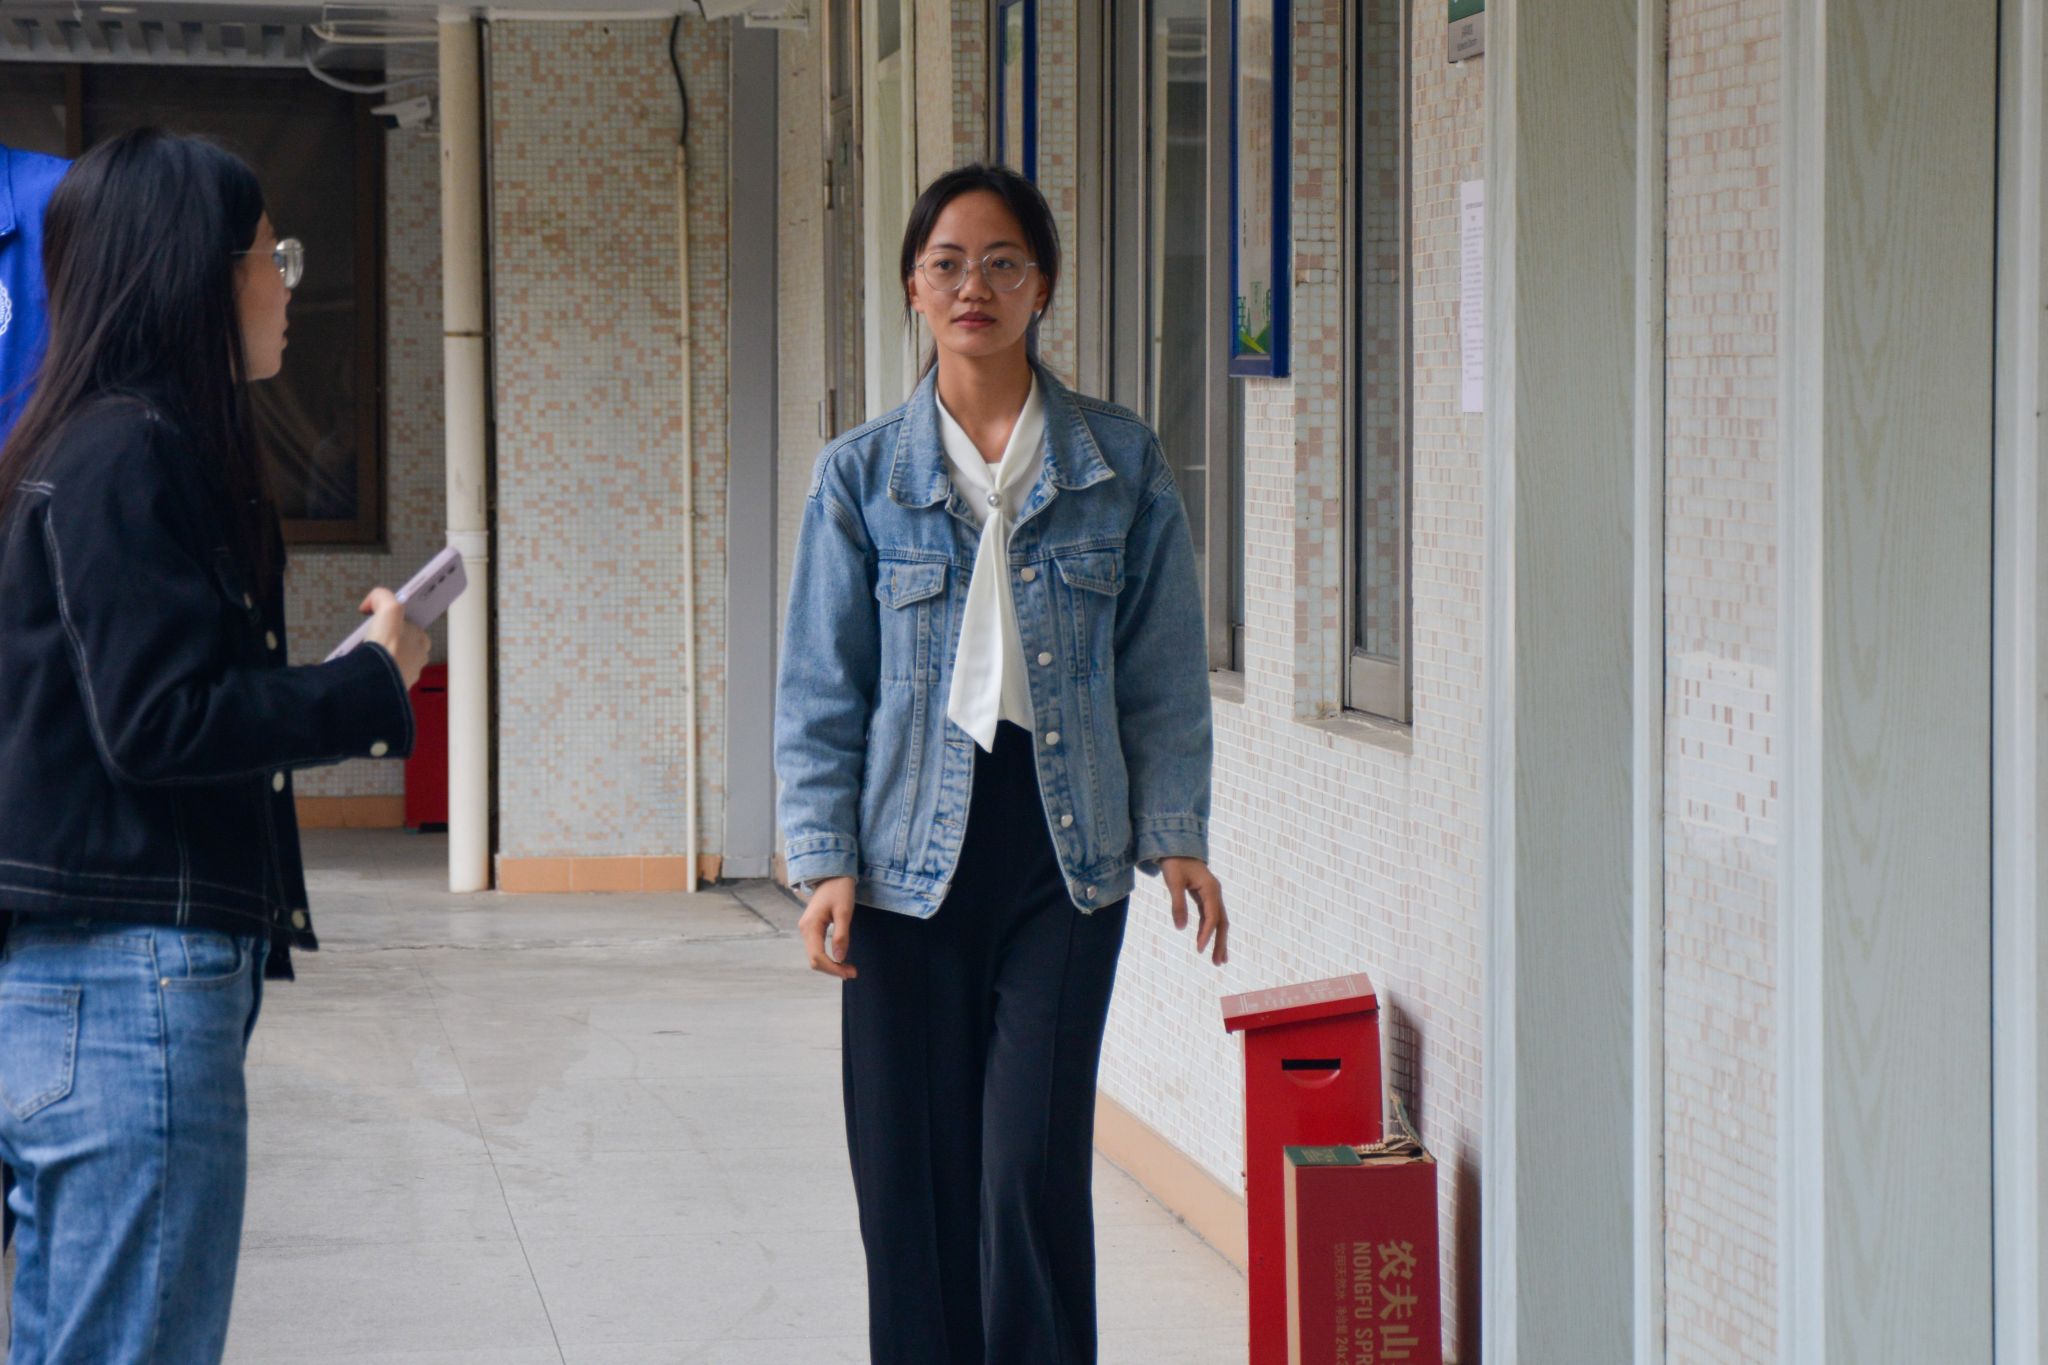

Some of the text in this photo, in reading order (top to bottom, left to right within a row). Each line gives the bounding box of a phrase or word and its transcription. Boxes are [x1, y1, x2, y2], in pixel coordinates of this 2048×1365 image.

[1353, 1242, 1374, 1365] NONGFU SPR
[1378, 1240, 1419, 1365] 农夫山
